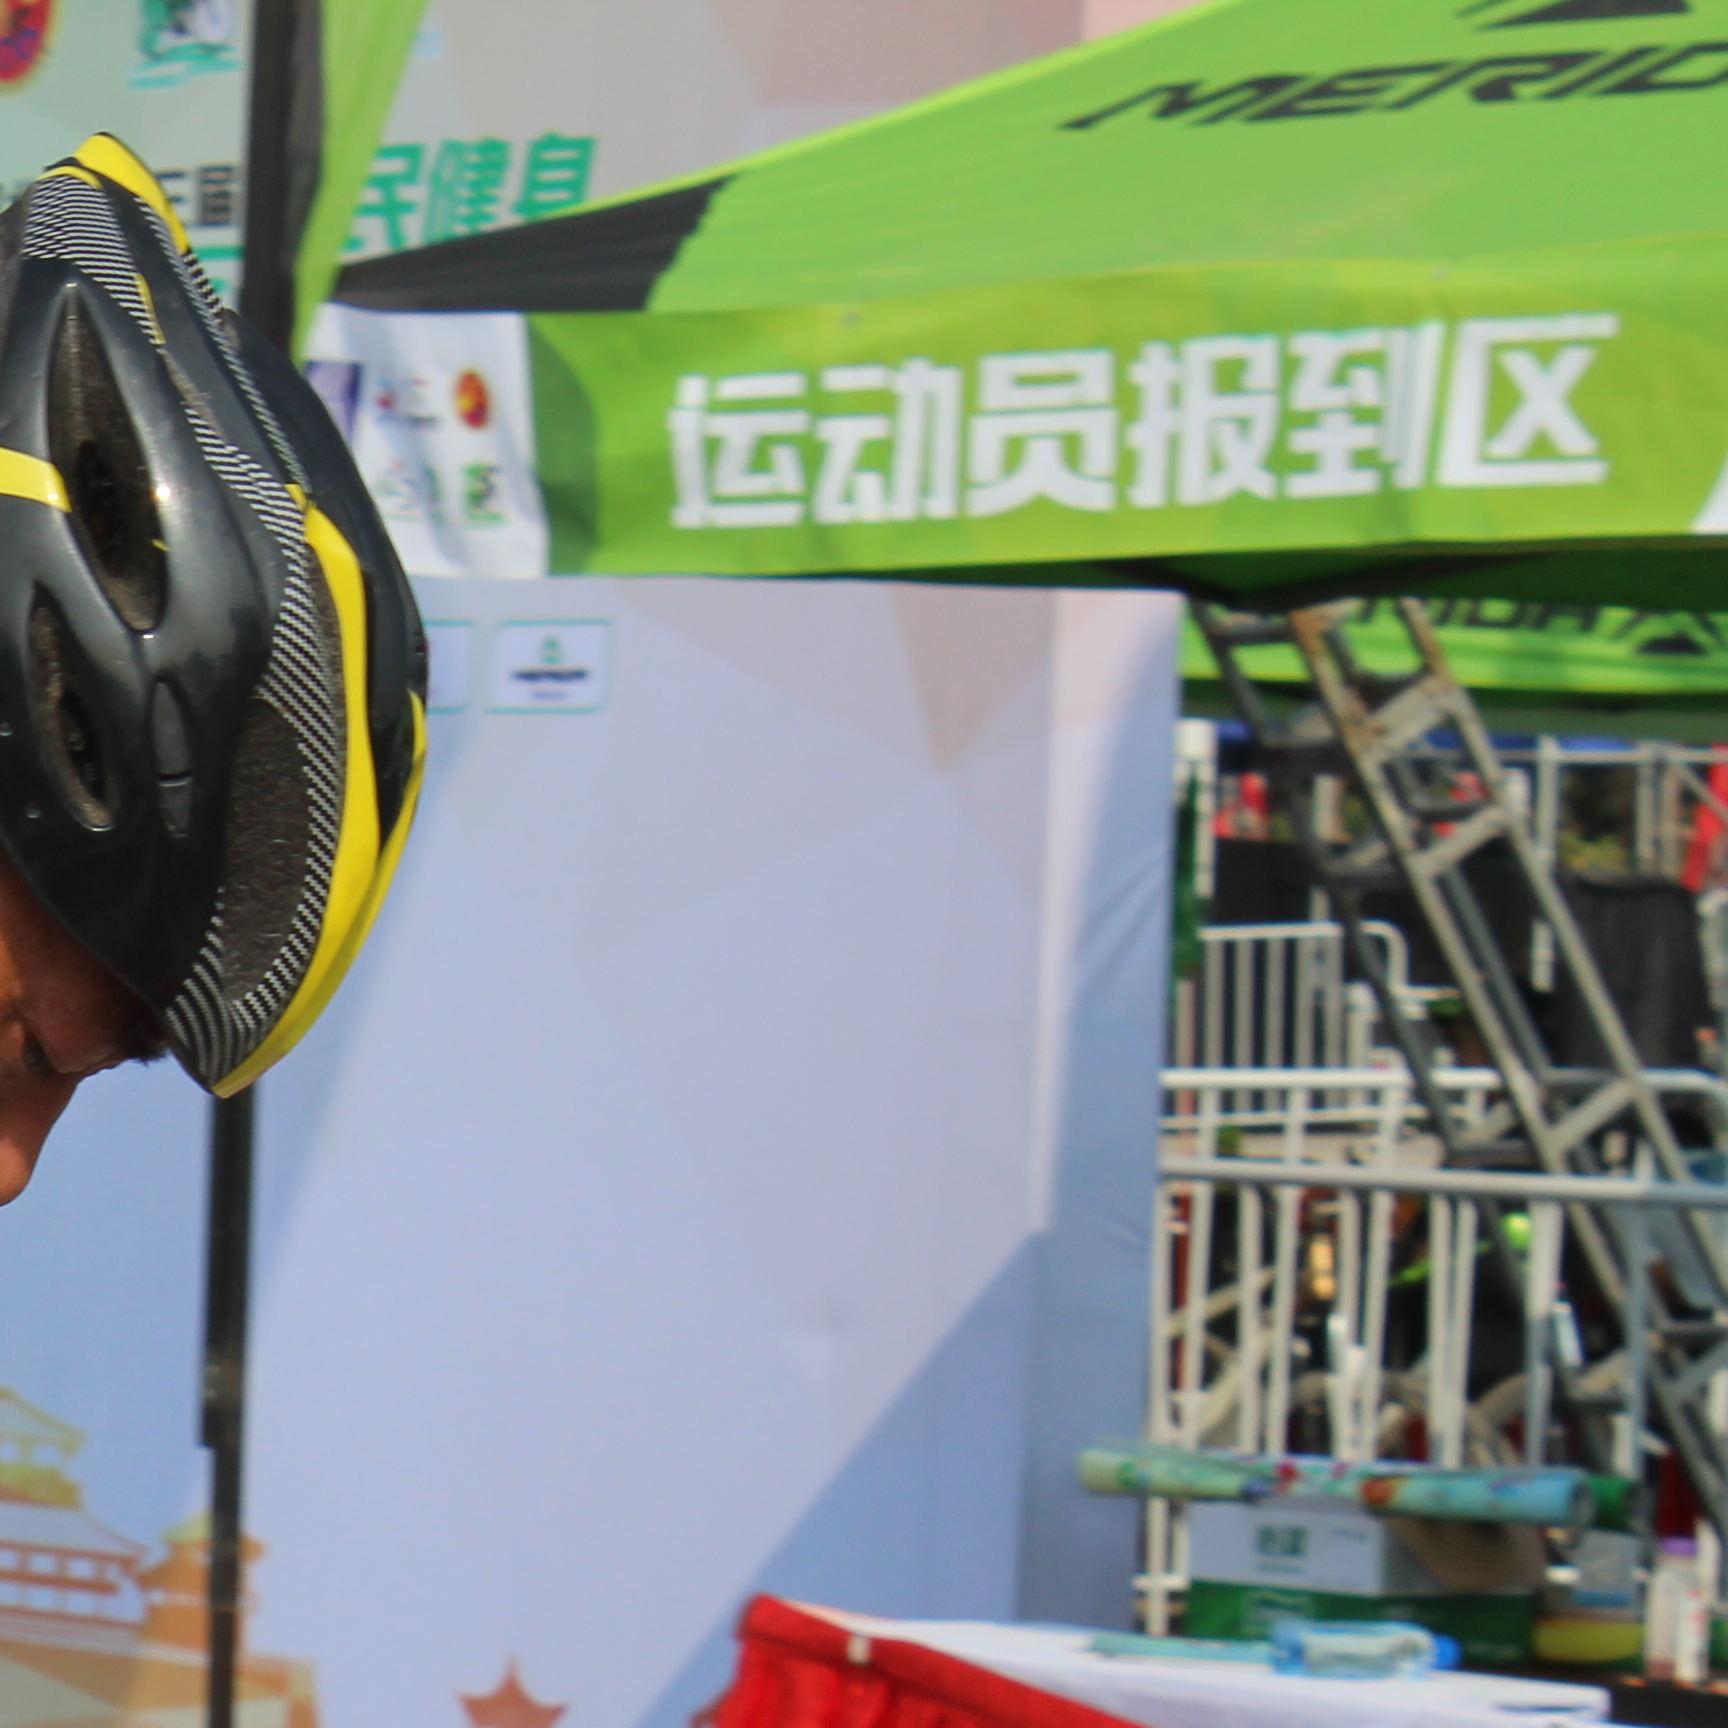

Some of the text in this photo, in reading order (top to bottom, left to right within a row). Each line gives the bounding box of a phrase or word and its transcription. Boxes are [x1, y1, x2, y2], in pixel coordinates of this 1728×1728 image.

[668, 312, 1621, 530] 运动员报到区
